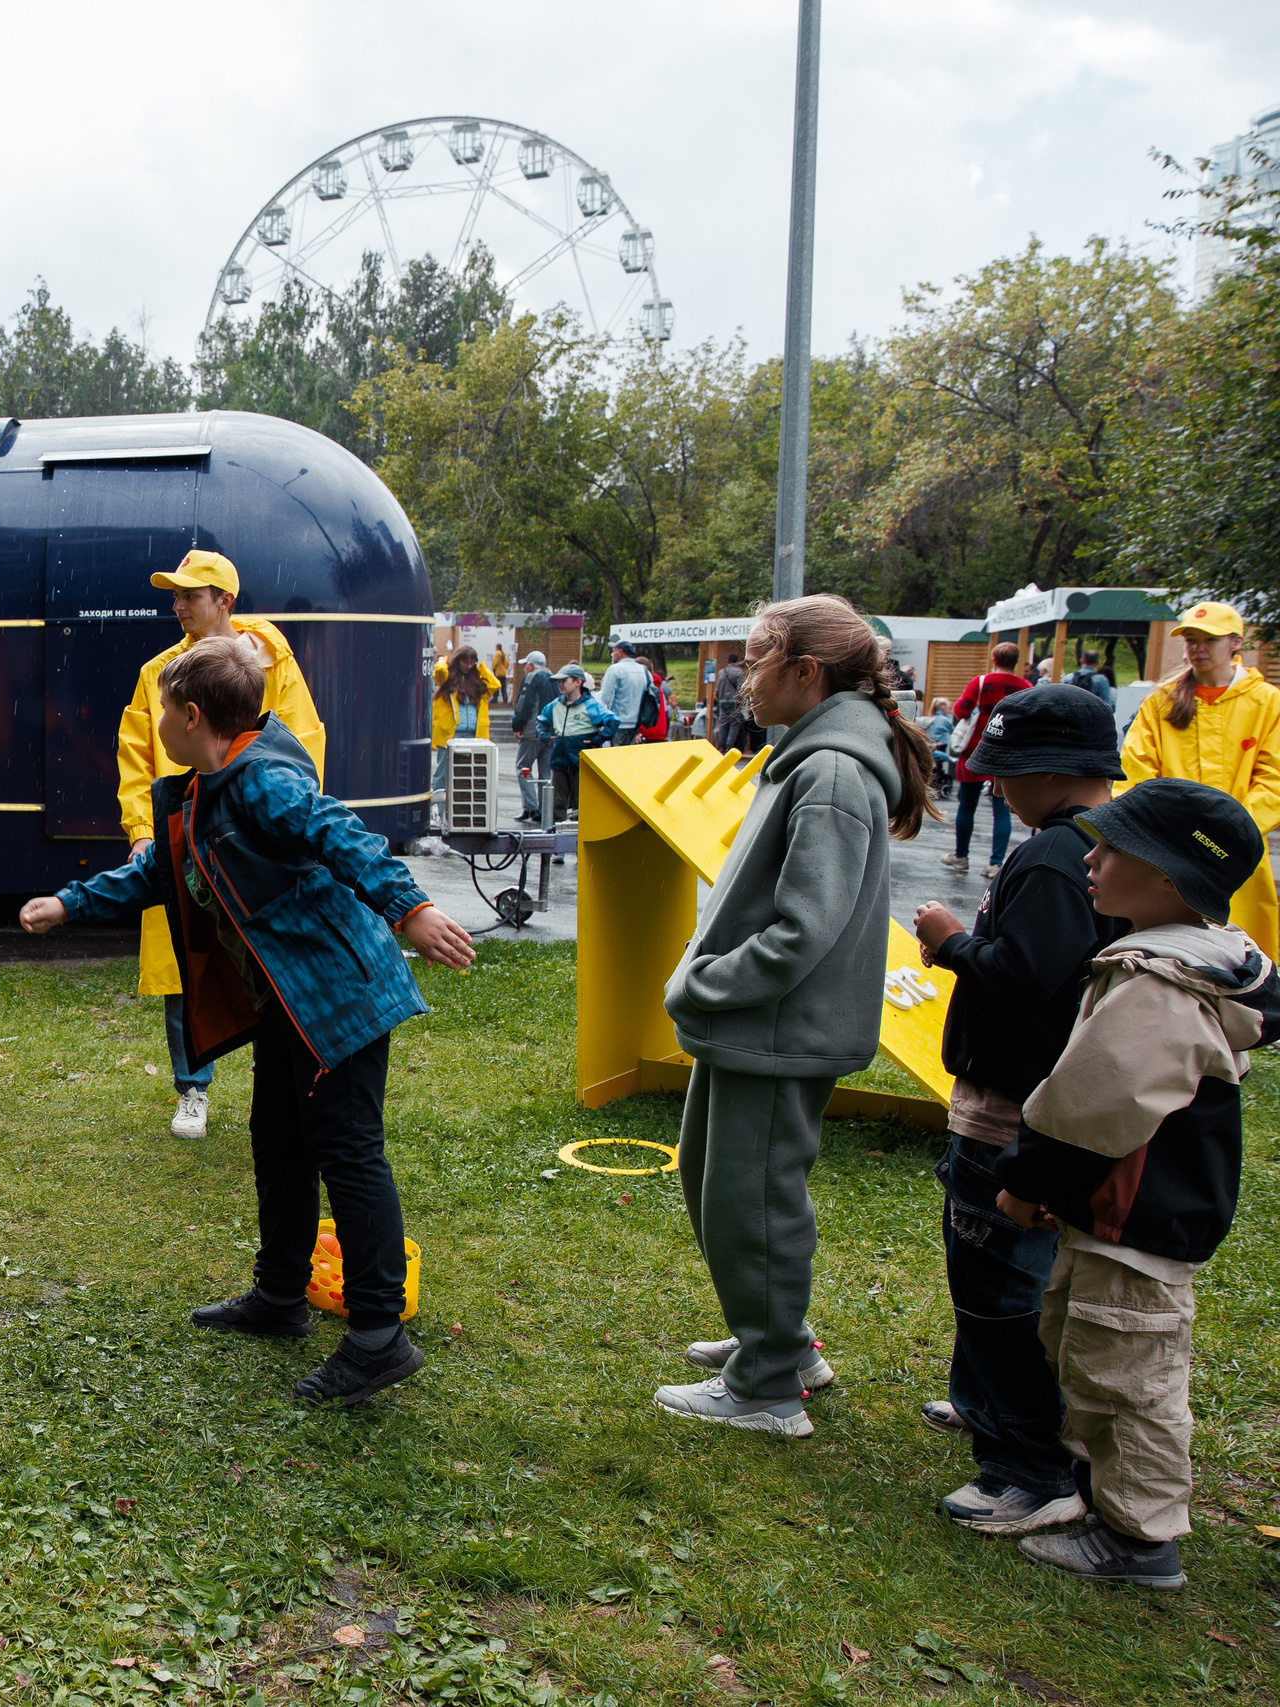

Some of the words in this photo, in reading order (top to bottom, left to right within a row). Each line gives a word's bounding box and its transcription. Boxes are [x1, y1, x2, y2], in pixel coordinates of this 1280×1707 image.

[78, 609, 113, 618] ЗАХОДИ
[114, 609, 127, 617] НЕ
[128, 608, 158, 617] БОЙСЯ
[629, 626, 707, 639] МАСТЕР-КЛАССЫ
[709, 626, 717, 636] И
[719, 624, 752, 636] ЭКСПЕ
[986, 724, 1004, 737] Kappa
[1191, 830, 1229, 860] RESPECT
